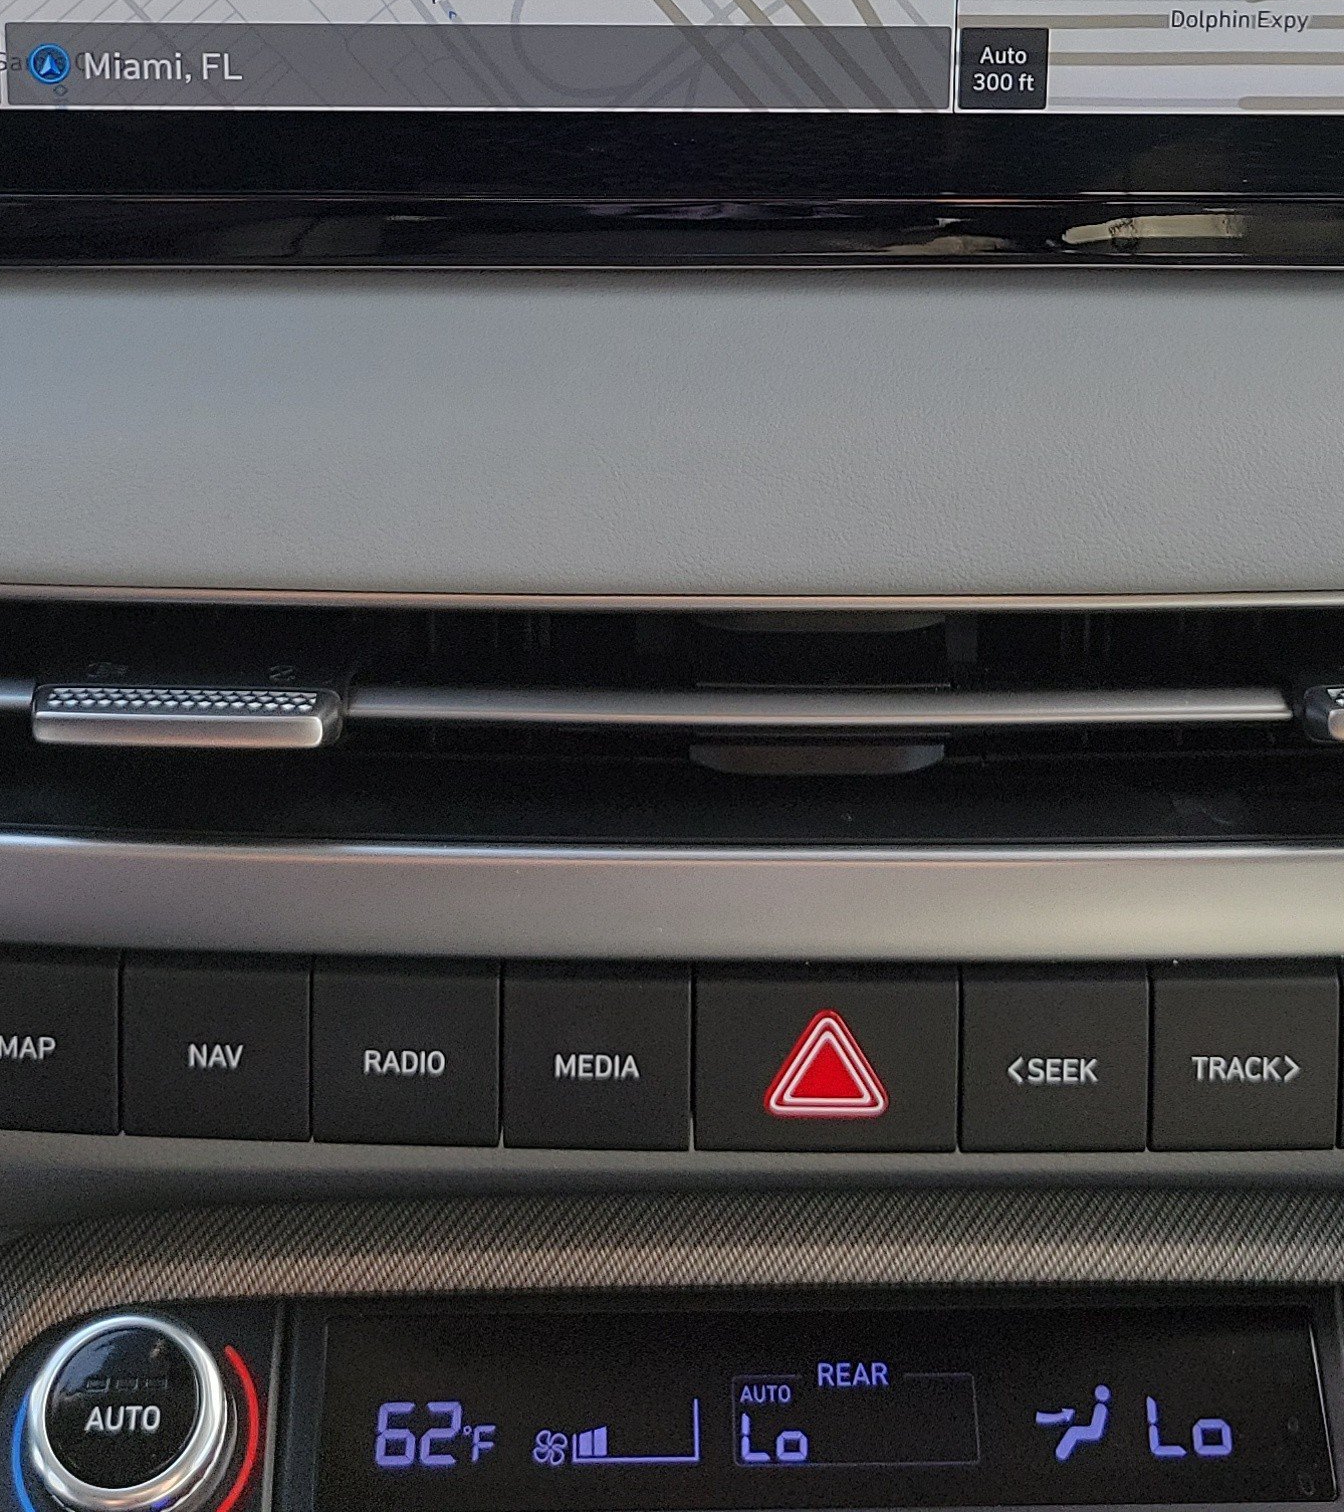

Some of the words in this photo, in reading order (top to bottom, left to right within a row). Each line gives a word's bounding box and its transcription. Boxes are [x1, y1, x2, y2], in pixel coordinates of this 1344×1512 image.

[1170, 9, 1250, 35] Dolphin
[1257, 11, 1309, 35] Expy
[83, 51, 193, 84] Miami,
[201, 54, 243, 81] FL
[979, 46, 1028, 67] Auto
[972, 72, 1011, 93] 300
[1015, 71, 1035, 93] ft
[188, 1043, 244, 1070] NAV
[363, 1049, 447, 1077] RADIO
[553, 1054, 640, 1081] MEDIA
[816, 1362, 890, 1388] REAR
[740, 1384, 791, 1404] AUTO
[85, 1405, 161, 1433] AUTO
